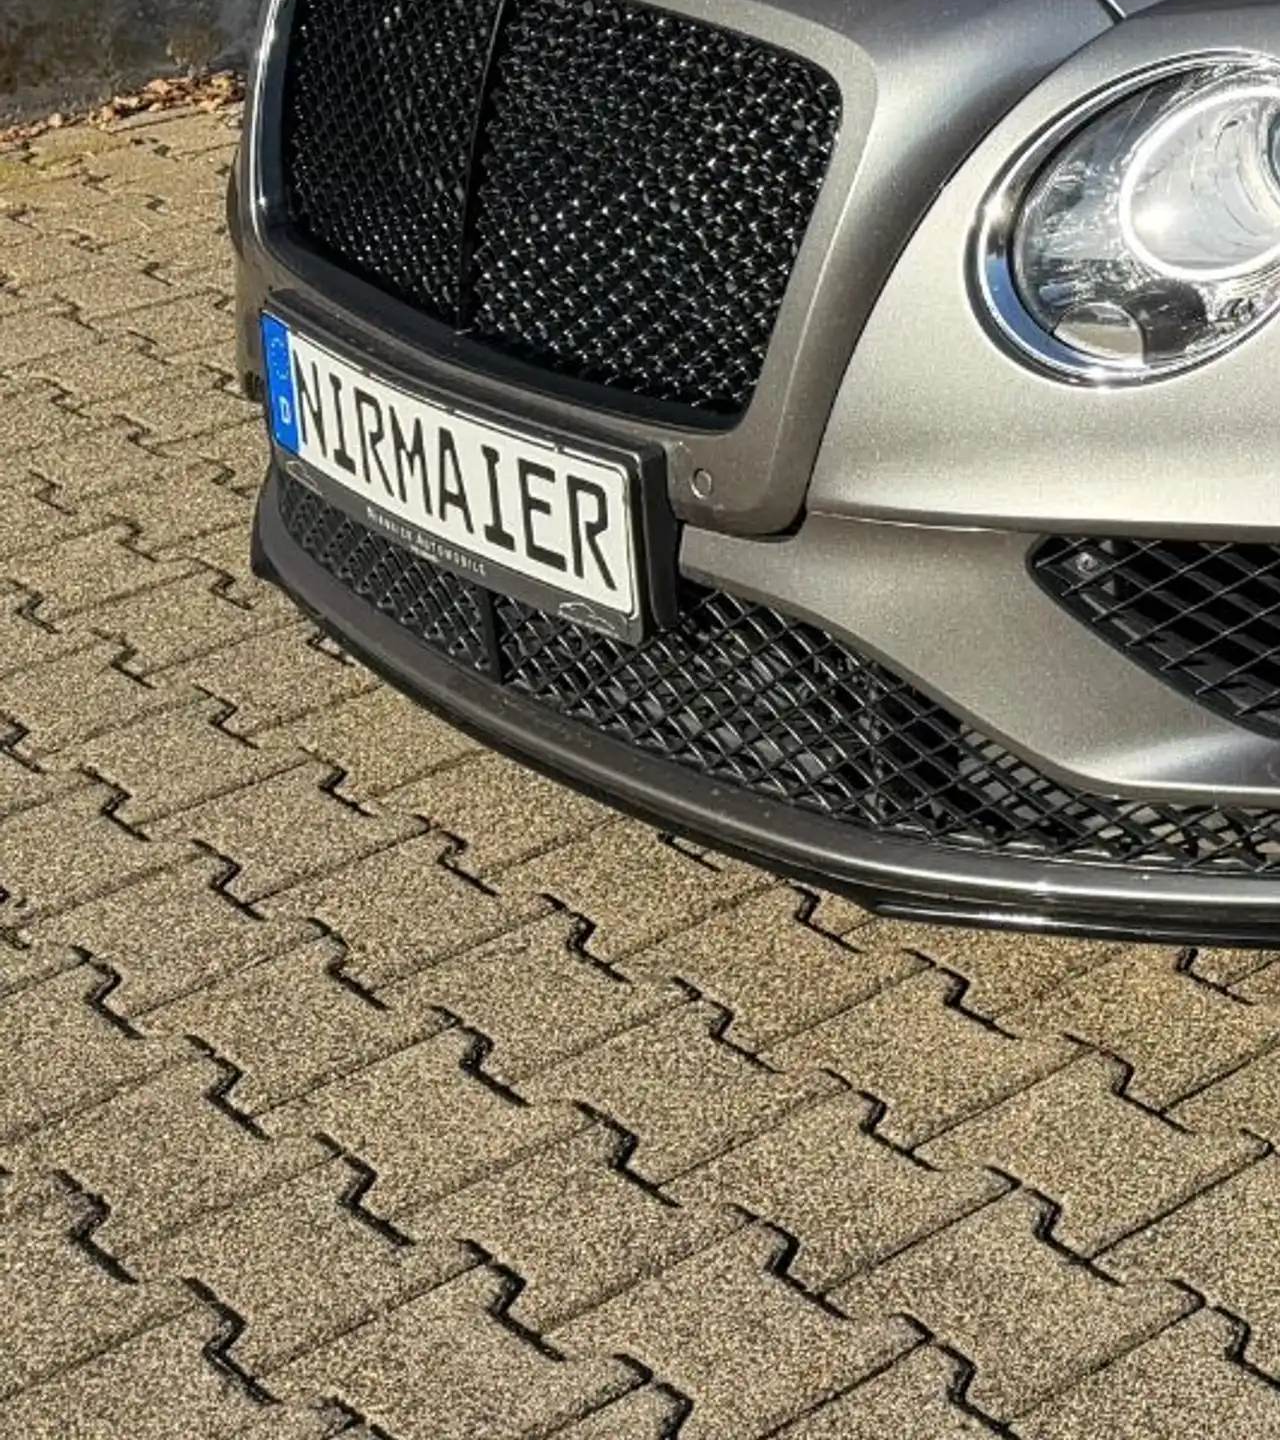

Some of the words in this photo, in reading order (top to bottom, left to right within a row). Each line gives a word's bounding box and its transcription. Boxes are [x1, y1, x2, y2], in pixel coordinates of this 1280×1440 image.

[278, 395, 292, 425] D
[292, 347, 618, 592] NIRMAIER
[415, 530, 487, 578] AUTOMOBILE
